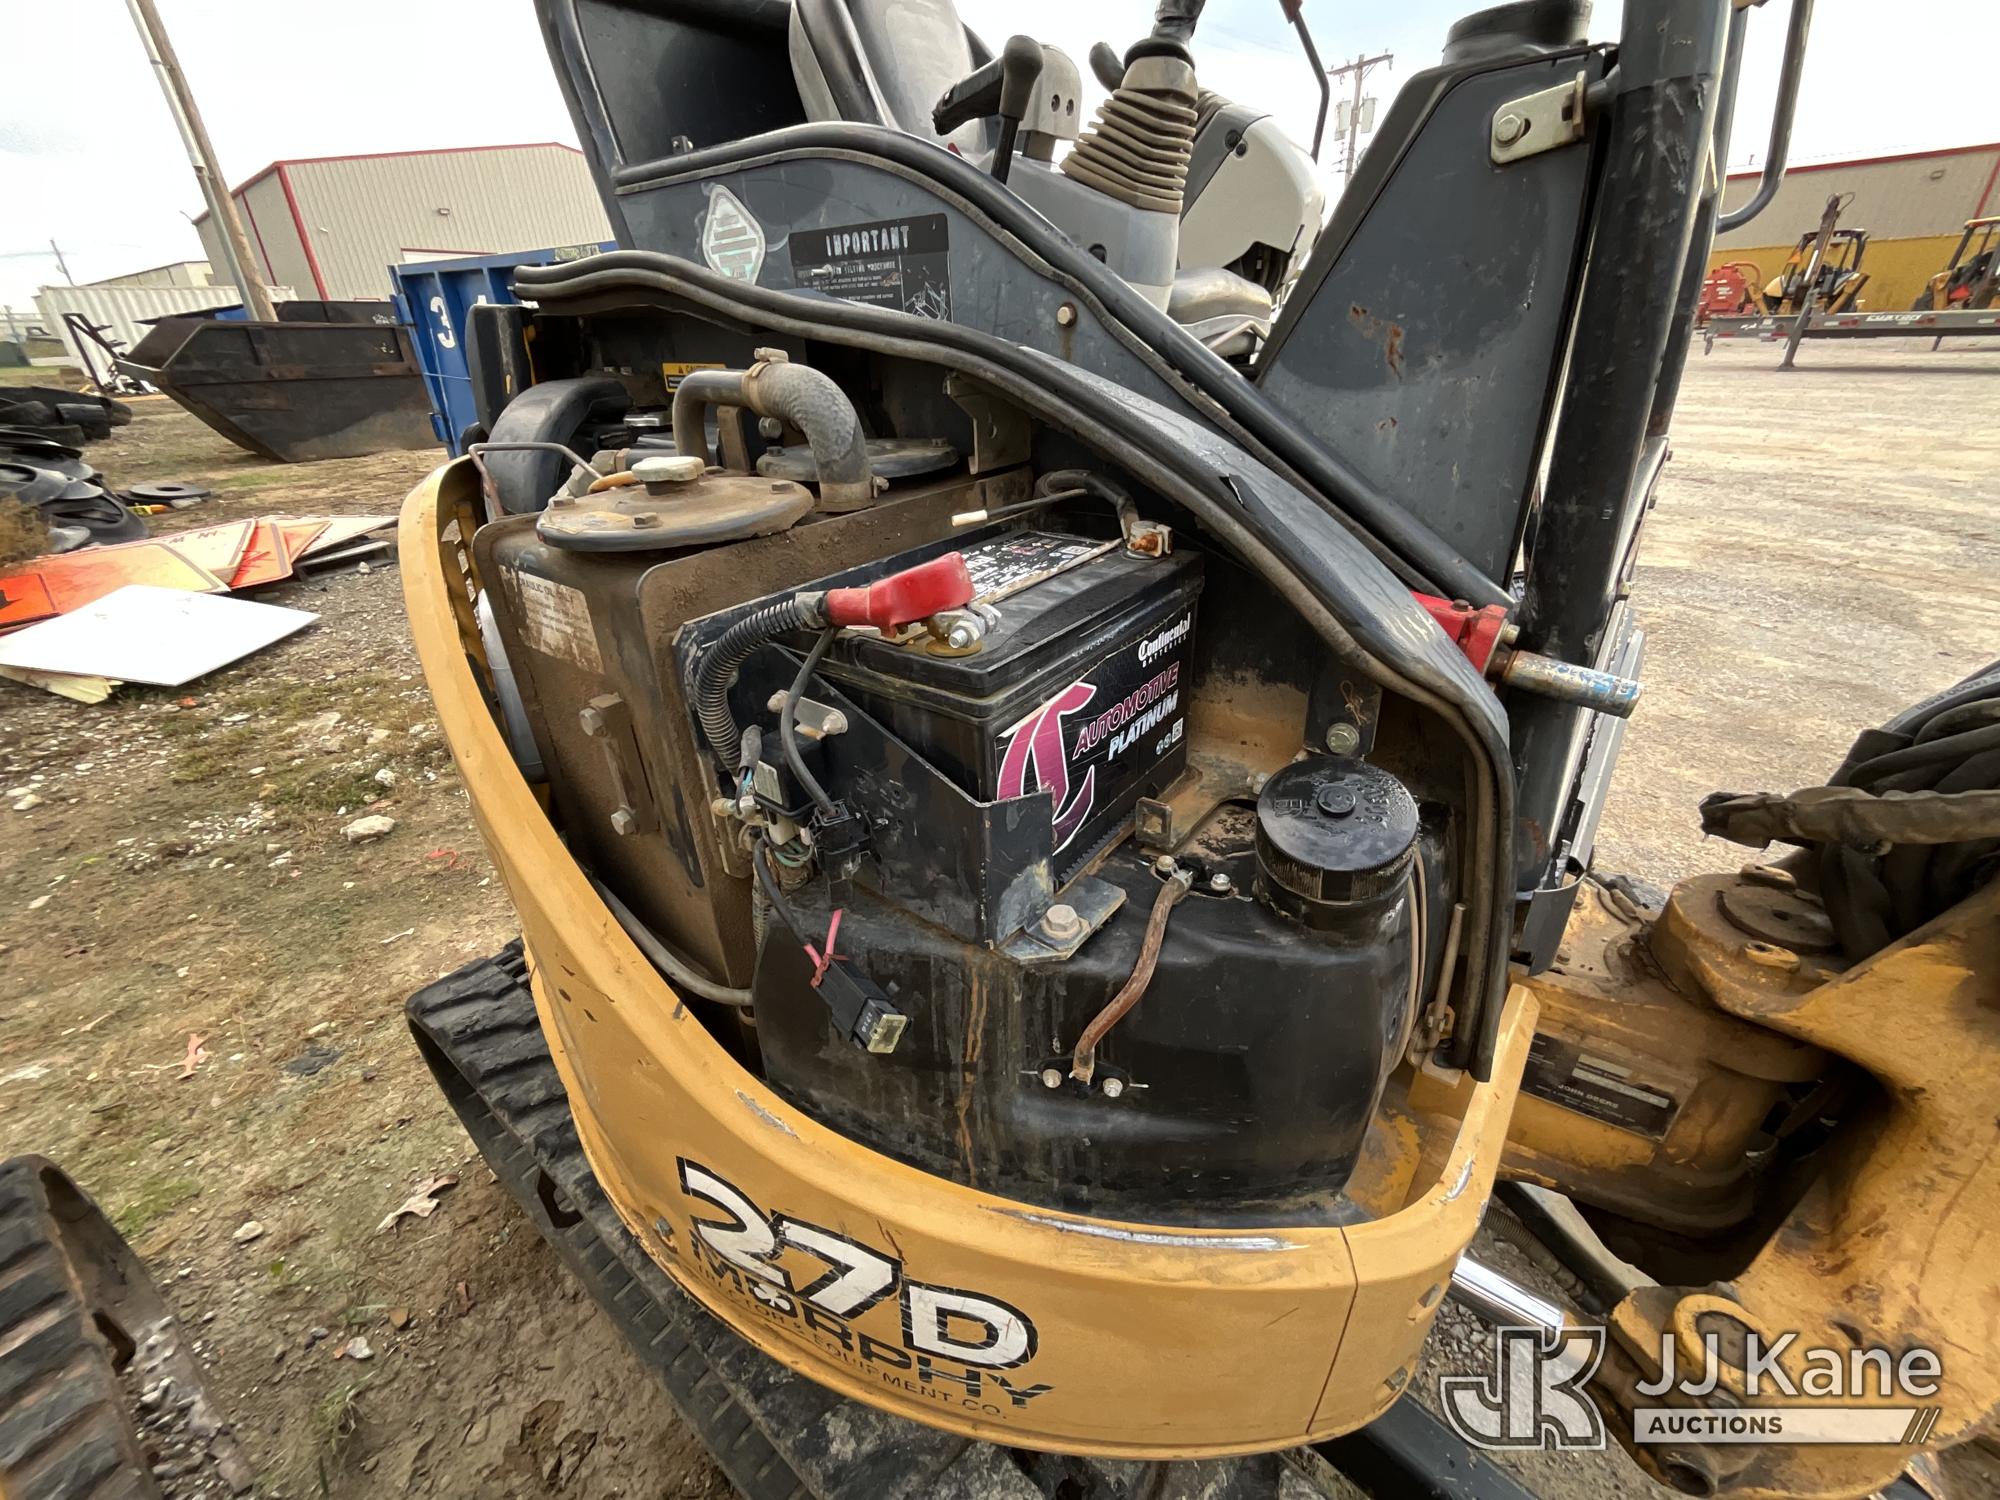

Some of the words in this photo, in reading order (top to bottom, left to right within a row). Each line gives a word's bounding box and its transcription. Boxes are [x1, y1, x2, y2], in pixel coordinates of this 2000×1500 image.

[826, 226, 909, 256] IMPORTANT
[430, 297, 455, 348] 3
[1138, 612, 1191, 662] Continental
[1142, 634, 1187, 668] BATTERIES
[1072, 661, 1180, 760] AUTOMOTIVE
[1108, 689, 1179, 761] PLATINUM
[676, 1156, 1039, 1370] 27D
[814, 1334, 952, 1402] EQUIPMENT
[962, 1398, 1008, 1419] CO.
